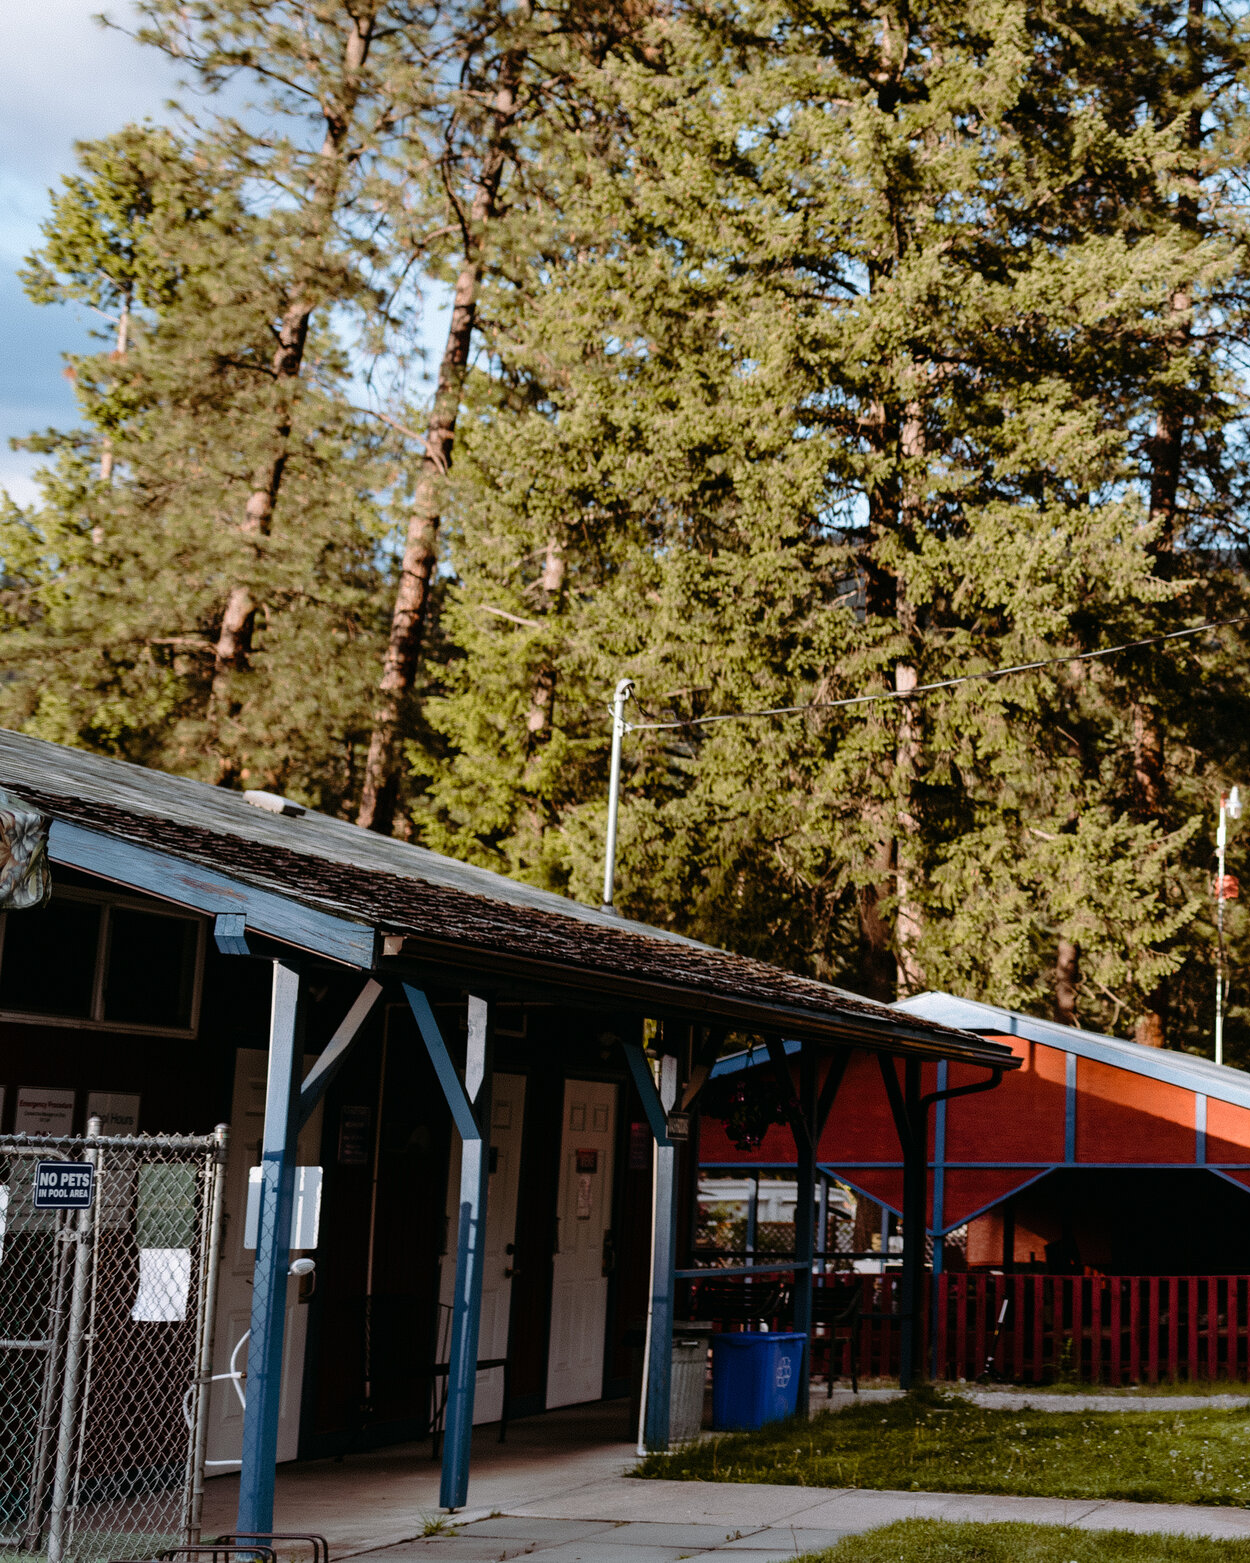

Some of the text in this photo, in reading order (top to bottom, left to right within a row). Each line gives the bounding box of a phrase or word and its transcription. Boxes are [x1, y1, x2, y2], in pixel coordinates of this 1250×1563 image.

[19, 1099, 47, 1109] Emergency
[90, 1112, 134, 1125] ol Hours
[39, 1172, 58, 1187] NO
[60, 1172, 90, 1187] PETS
[38, 1188, 88, 1198] IN POOL AREA
